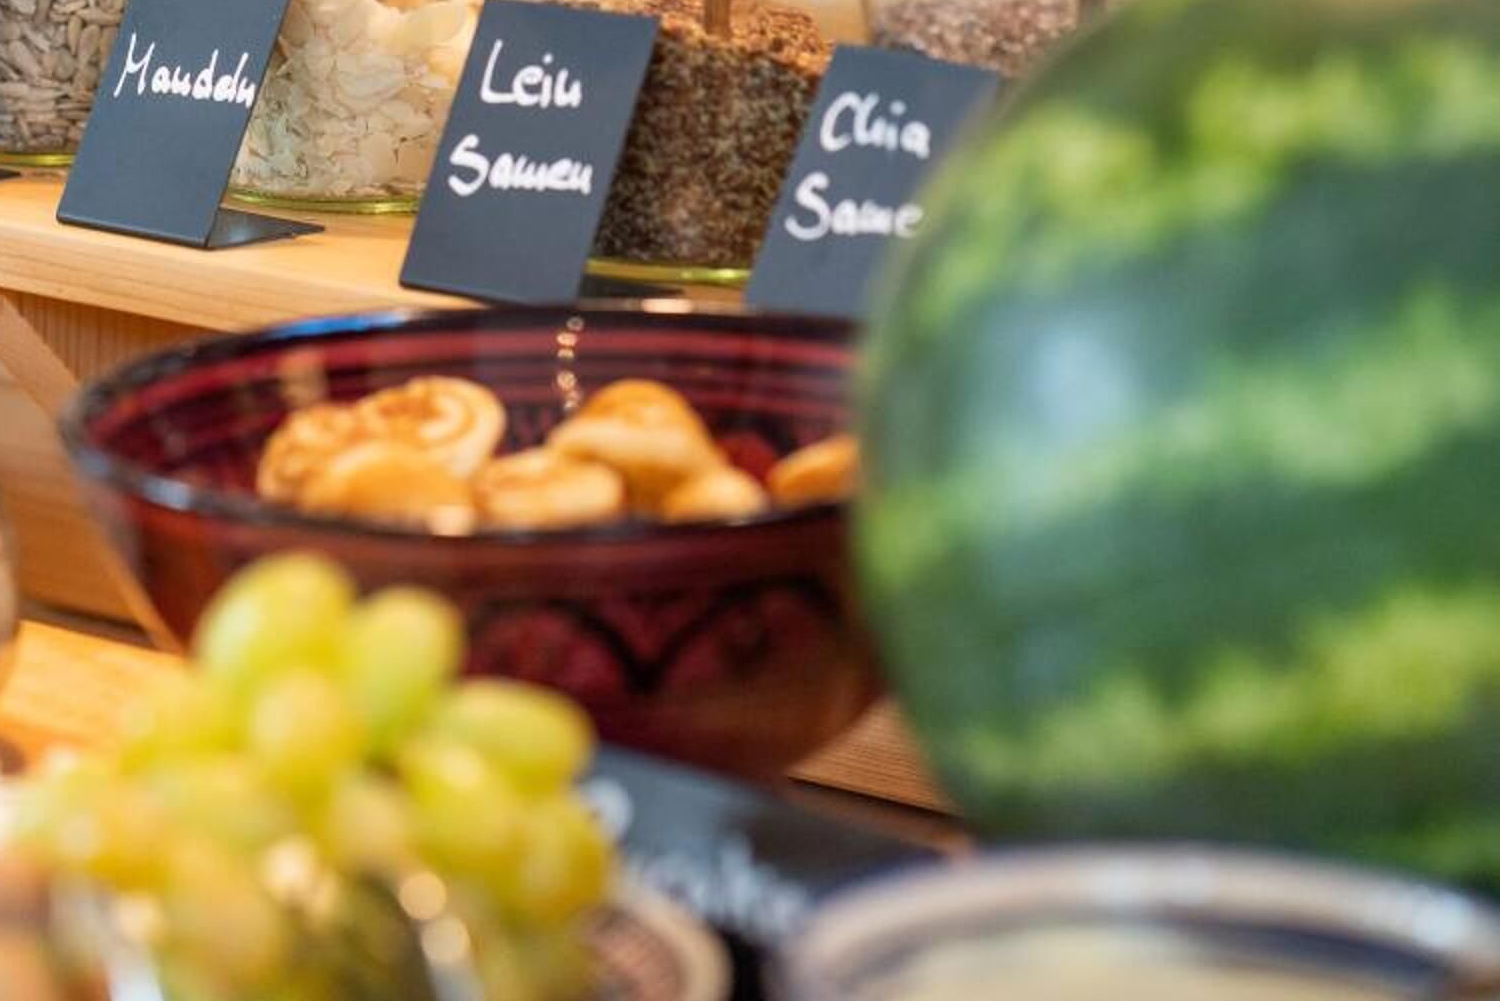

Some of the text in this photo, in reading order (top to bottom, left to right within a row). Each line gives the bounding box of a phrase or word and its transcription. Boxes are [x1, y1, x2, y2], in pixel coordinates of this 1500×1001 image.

[114, 33, 257, 109] Mandeln
[481, 39, 583, 108] Lein
[820, 90, 931, 160] Chia
[449, 134, 593, 197] Samen
[785, 172, 925, 240] Same
